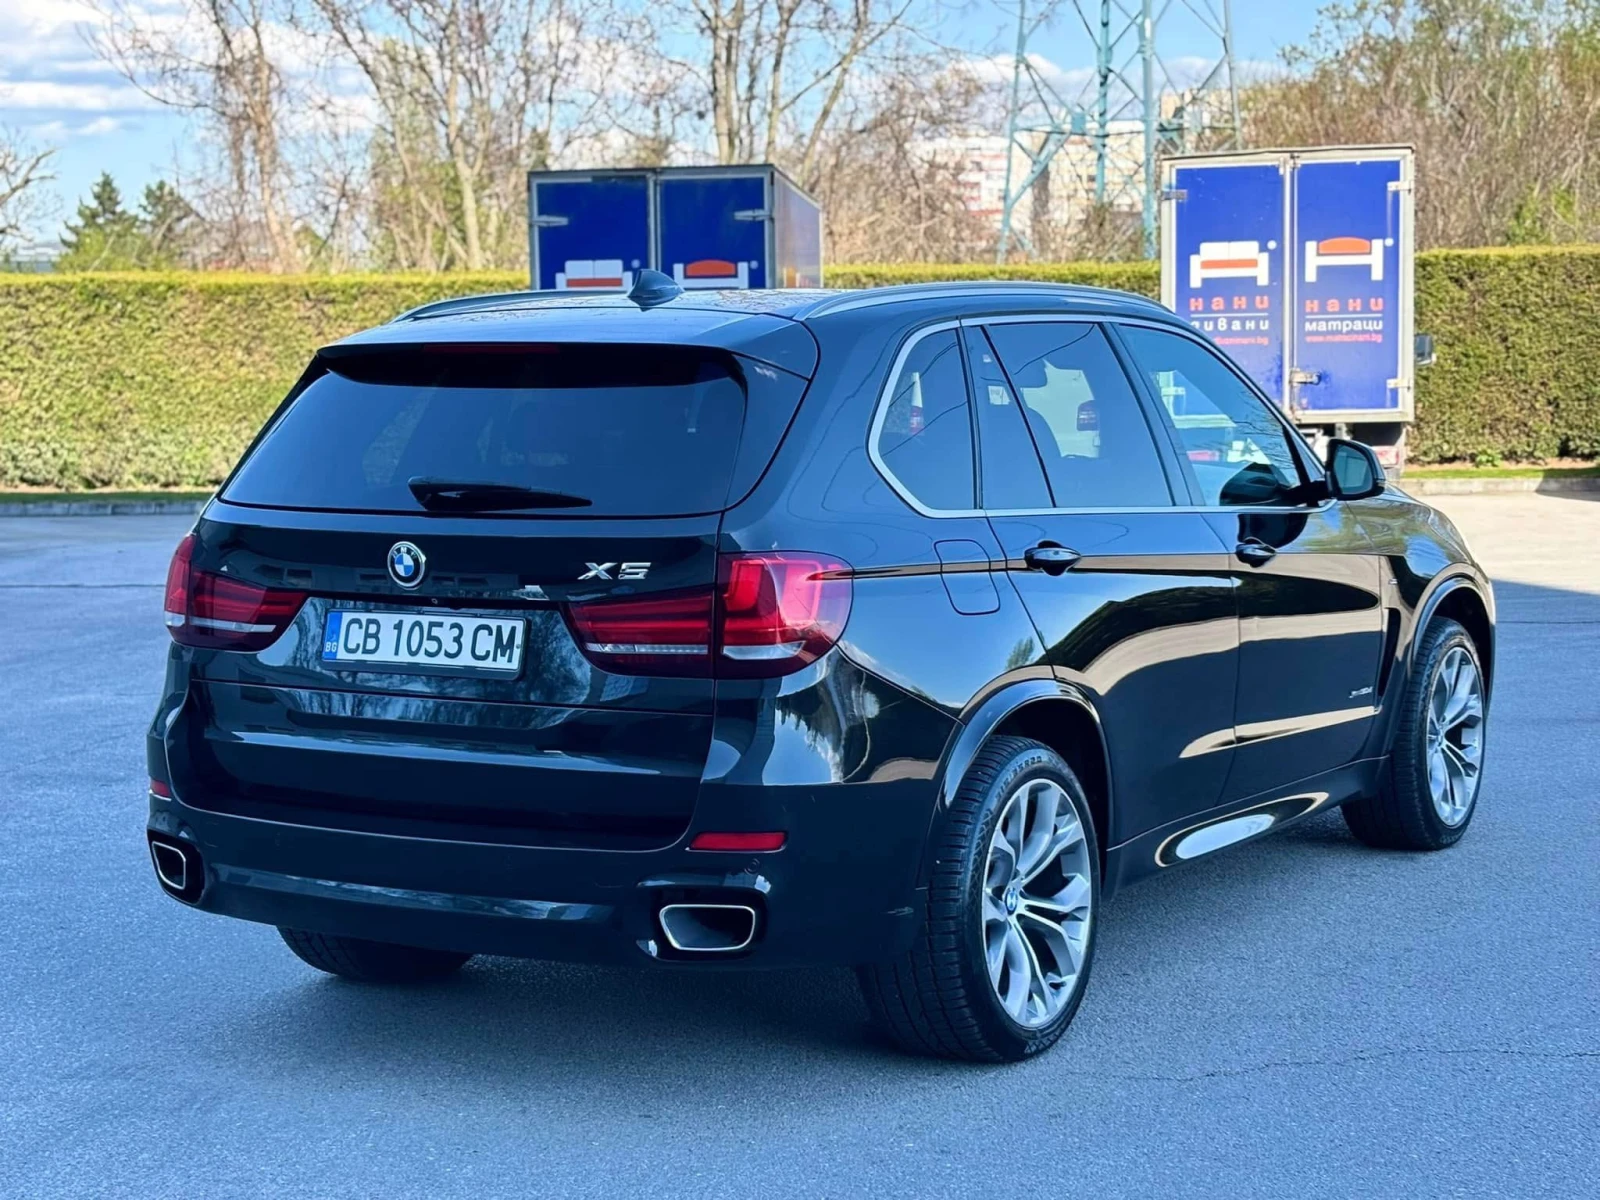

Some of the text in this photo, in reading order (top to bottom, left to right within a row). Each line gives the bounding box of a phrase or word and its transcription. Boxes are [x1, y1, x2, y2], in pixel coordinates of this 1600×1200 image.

[1189, 296, 1269, 311] нани
[1305, 298, 1384, 312] нани
[1305, 320, 1383, 333] матраци
[577, 562, 652, 580] X5
[325, 641, 338, 653] BG
[343, 617, 517, 663] CB 1053 CM
